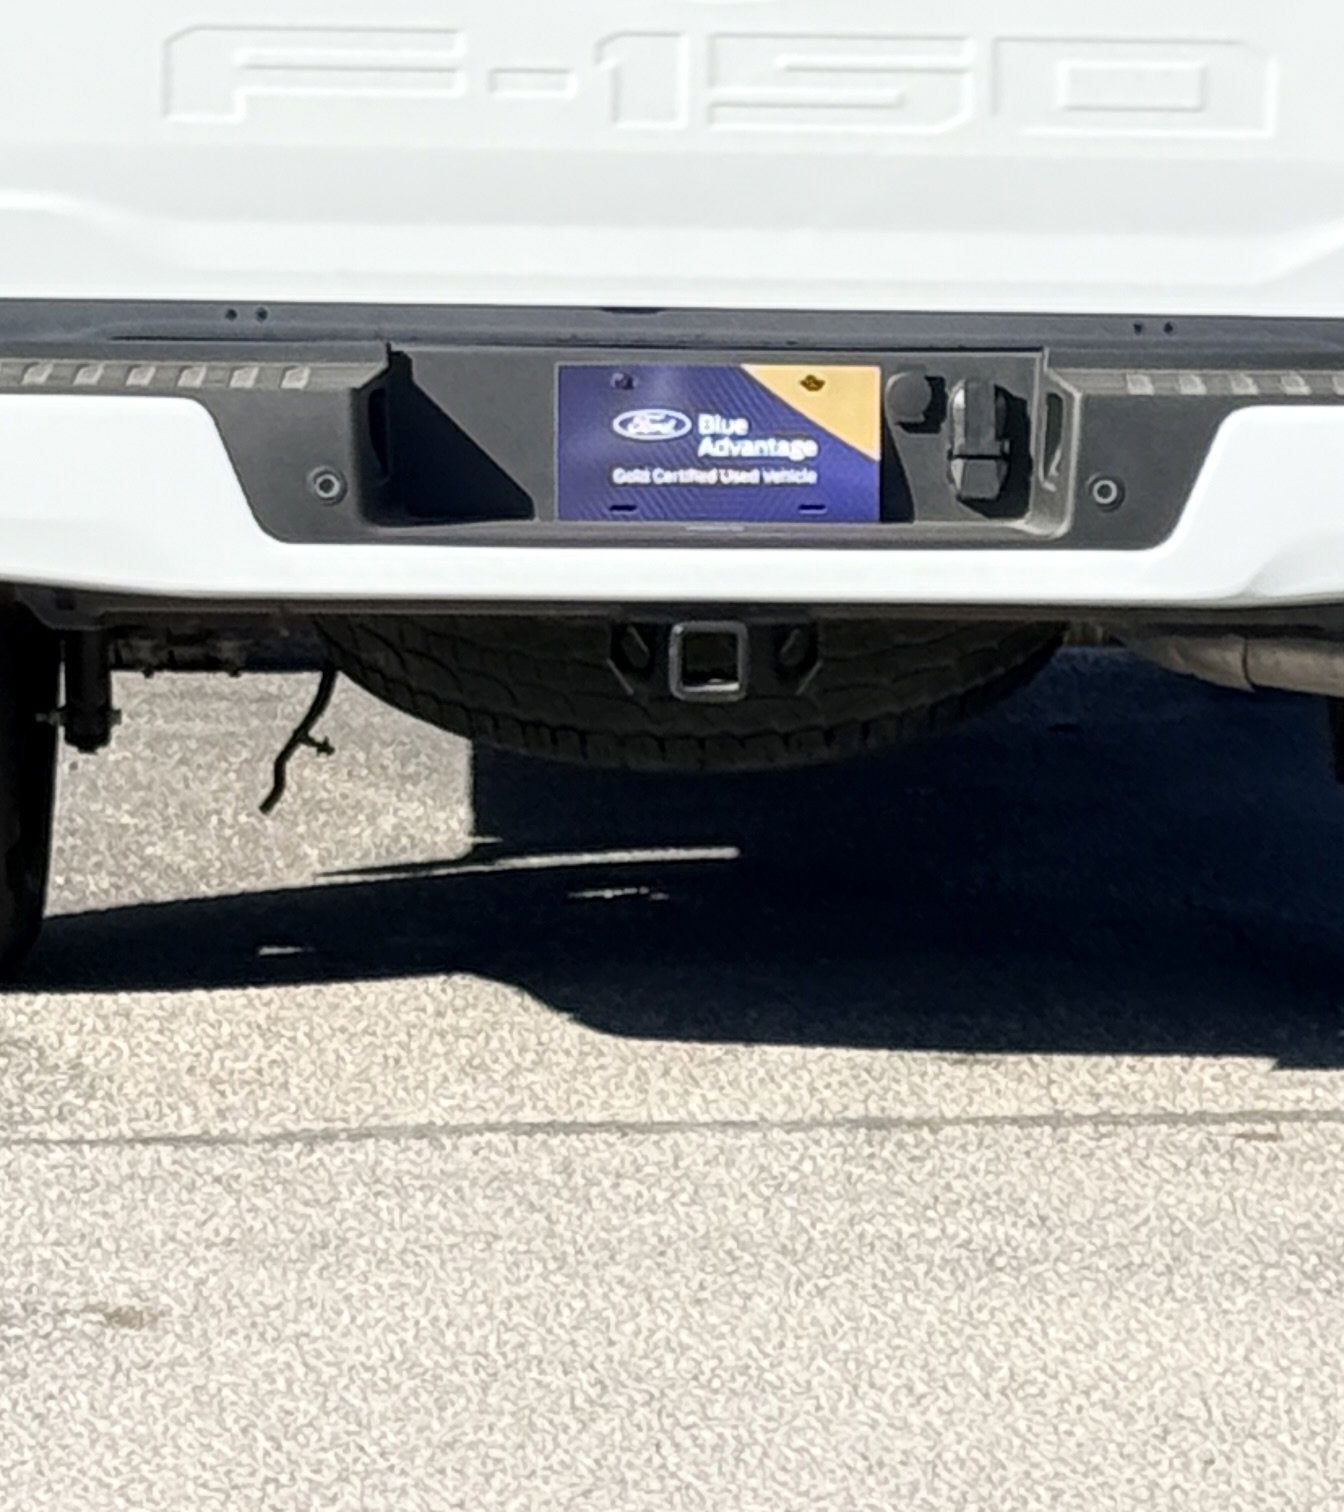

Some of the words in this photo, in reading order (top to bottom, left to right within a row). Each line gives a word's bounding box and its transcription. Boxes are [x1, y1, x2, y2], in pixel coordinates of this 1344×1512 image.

[163, 23, 1276, 136] F-150
[698, 413, 749, 436] Blue
[697, 436, 818, 461] Advantage
[612, 467, 651, 485] Gold
[652, 467, 718, 485] Certified
[719, 467, 760, 485] Used
[762, 467, 818, 485] Vehicle
